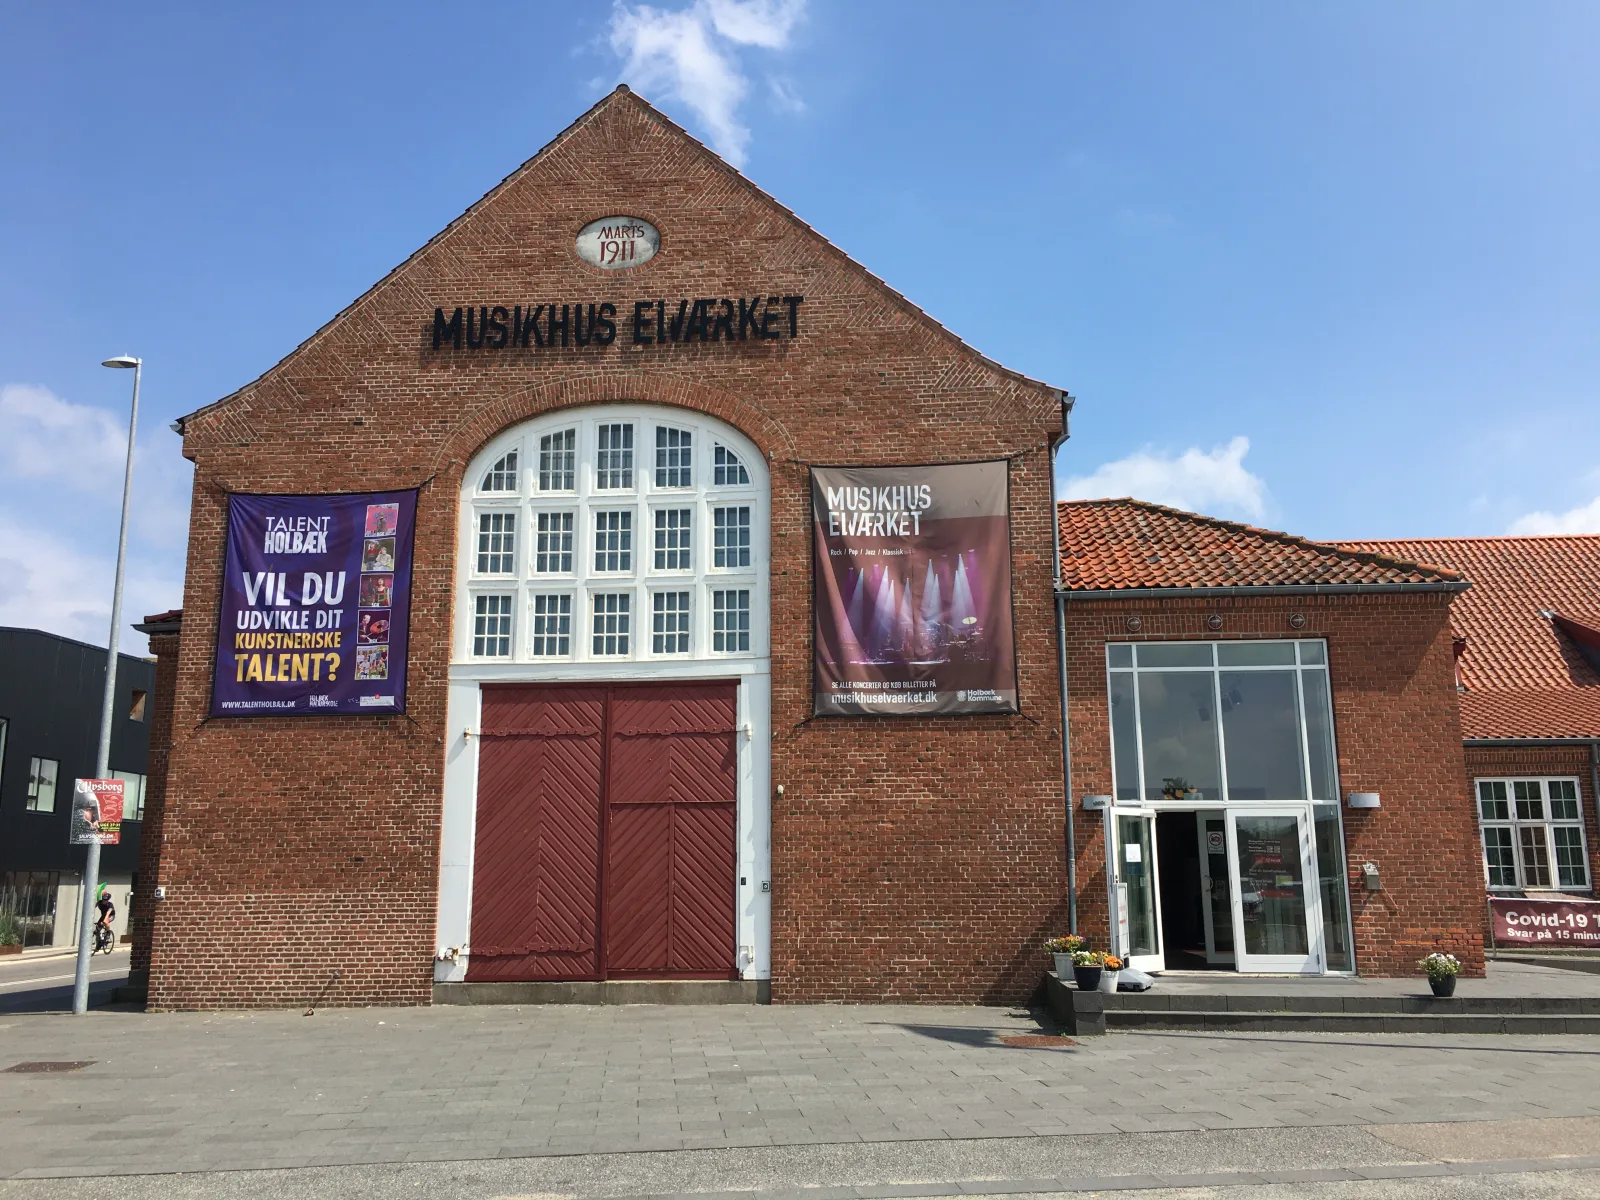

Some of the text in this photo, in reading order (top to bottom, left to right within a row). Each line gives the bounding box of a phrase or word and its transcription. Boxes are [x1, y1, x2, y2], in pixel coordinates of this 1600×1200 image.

[597, 225, 645, 239] MARTS
[599, 240, 635, 265] 1911
[432, 302, 617, 350] MUSIKHUS
[827, 484, 932, 511] MUSIKHUS
[266, 516, 331, 532] TALENT
[264, 531, 329, 554] HOLBÆK
[242, 571, 346, 606] VIL DU
[236, 609, 344, 630] UDVIKLE DIT
[234, 632, 342, 649] KUNSTNERISKE
[234, 652, 341, 682] TALENT?
[832, 691, 938, 704] musikhuselvaerket.dk
[1506, 912, 1588, 928] Covid-19
[1507, 928, 1534, 938] Svar
[1537, 929, 1552, 939] på
[1556, 930, 1570, 938] 15
